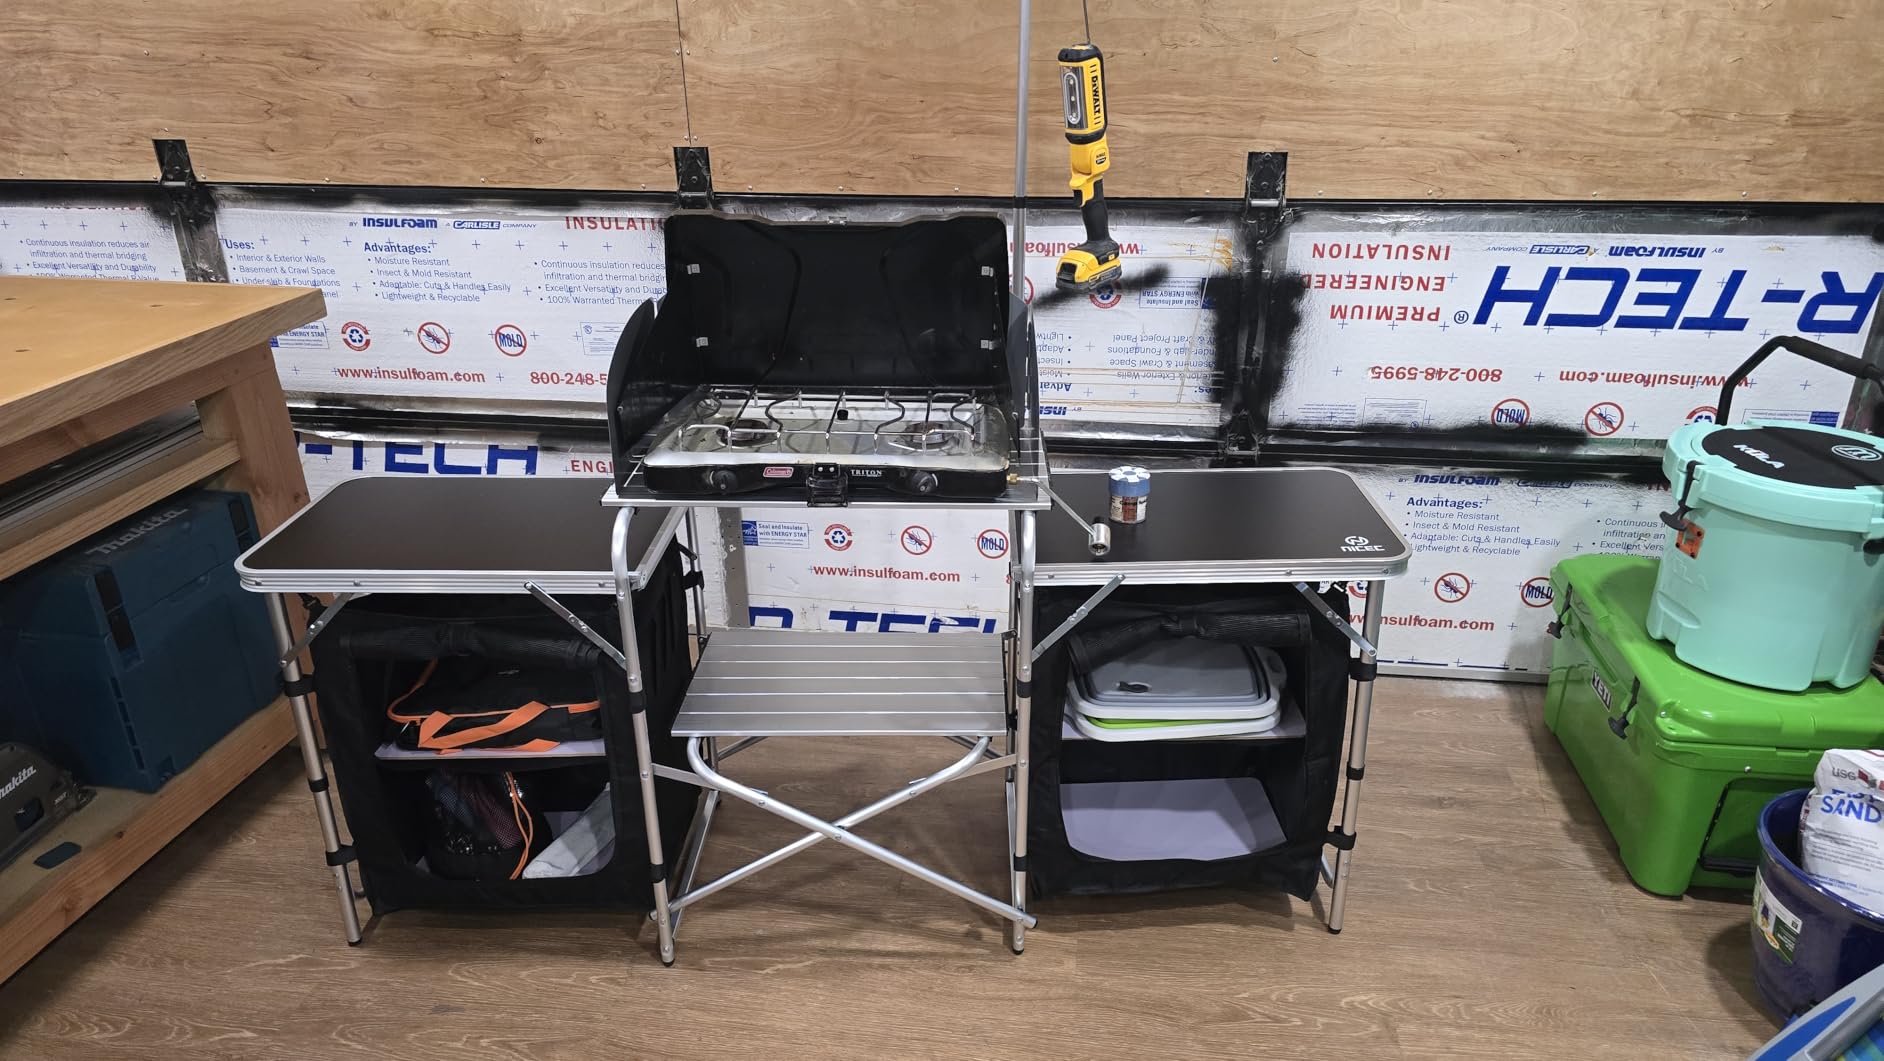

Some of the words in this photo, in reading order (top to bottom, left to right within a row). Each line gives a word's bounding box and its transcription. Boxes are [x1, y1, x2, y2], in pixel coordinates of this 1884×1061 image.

[454, 221, 500, 229] CARLISLE
[565, 216, 665, 231] INSULATI
[26, 239, 68, 247] Continuous
[70, 239, 106, 248] insulation
[107, 241, 142, 249] reduces
[225, 239, 255, 250] Uses:
[364, 242, 432, 255] Advantages:
[1531, 244, 1589, 255] CARLISLE
[30, 250, 67, 258] infiltration
[85, 251, 113, 259] thermal
[116, 252, 147, 261] bridging
[1312, 242, 1451, 261] INSULATION
[236, 254, 264, 262] Interior
[274, 254, 303, 262] Exterior
[304, 255, 326, 263] Walls
[374, 256, 410, 265] Moisture
[412, 257, 450, 266] Resistant
[32, 261, 65, 269] Excellent
[66, 262, 103, 271] Versatility
[105, 263, 119, 271] and
[121, 263, 157, 272] Durability
[239, 265, 277, 274] Basement
[280, 266, 286, 274] &
[288, 266, 309, 274] Crawl
[311, 267, 335, 275] Space
[541, 260, 588, 269] Continuous
[590, 261, 629, 270] insulation
[632, 261, 665, 270] reduces
[376, 269, 402, 277] Insect
[403, 269, 410, 277] &
[434, 270, 472, 279] Resistant
[544, 271, 585, 281] infiltration
[587, 273, 603, 281] and
[605, 273, 637, 282] thermal
[640, 274, 666, 284] bridgi
[285, 278, 291, 286] &
[293, 278, 340, 287] Foundations
[379, 280, 422, 290] Adaptable:
[424, 282, 442, 290] Cuts
[444, 282, 450, 290] &
[452, 282, 486, 291] Handles
[488, 283, 511, 293] Easily
[1302, 274, 1447, 292] ENGINEERED
[321, 289, 339, 298] anel
[545, 284, 581, 293] Excellent
[583, 285, 623, 295] Versatility
[625, 285, 641, 294] and
[382, 291, 426, 301] Lightweight
[429, 293, 435, 301] &
[437, 293, 480, 303] Recyclable
[547, 295, 570, 304] 100%
[572, 296, 615, 305] Warranted
[617, 297, 645, 305] Therm
[1330, 304, 1441, 322] PREMIUM
[499, 333, 523, 348] MOLD
[1112, 334, 1138, 343] Panel
[1140, 334, 1171, 344] Project
[1198, 336, 1205, 344] &
[1107, 346, 1162, 356] Foundations
[1109, 358, 1137, 367] Space
[1139, 359, 1163, 368] Crawl
[1165, 360, 1172, 368] &
[337, 366, 485, 384] www.insulfoam.com
[1117, 371, 1140, 380] Walls
[1142, 372, 1176, 381] Exterior
[1371, 365, 1502, 382] 800-248-5995
[1406, 496, 1483, 510] Advantages:
[1414, 510, 1454, 520] Moisture
[1457, 512, 1500, 521] Resistant
[1412, 521, 1440, 530] Insect
[1441, 522, 1450, 530] &
[1453, 522, 1475, 531] Mold
[1477, 523, 1521, 533] Resistant
[1604, 518, 1658, 528] Continuous
[981, 537, 1005, 551] MOLD
[1410, 531, 1459, 543] Adaptable:
[1461, 534, 1482, 544] Cuts
[1483, 535, 1491, 544] &
[1494, 535, 1531, 545] Handles
[1534, 537, 1561, 547] Easily
[1463, 546, 1471, 554] &
[1473, 546, 1521, 556] Recyclable
[1600, 541, 1641, 550] Excellent
[813, 565, 960, 582] www.insulfoam.com
[1525, 586, 1553, 600] MOLD
[1594, 671, 1610, 706] YETI
[1820, 795, 1882, 823] SAND
